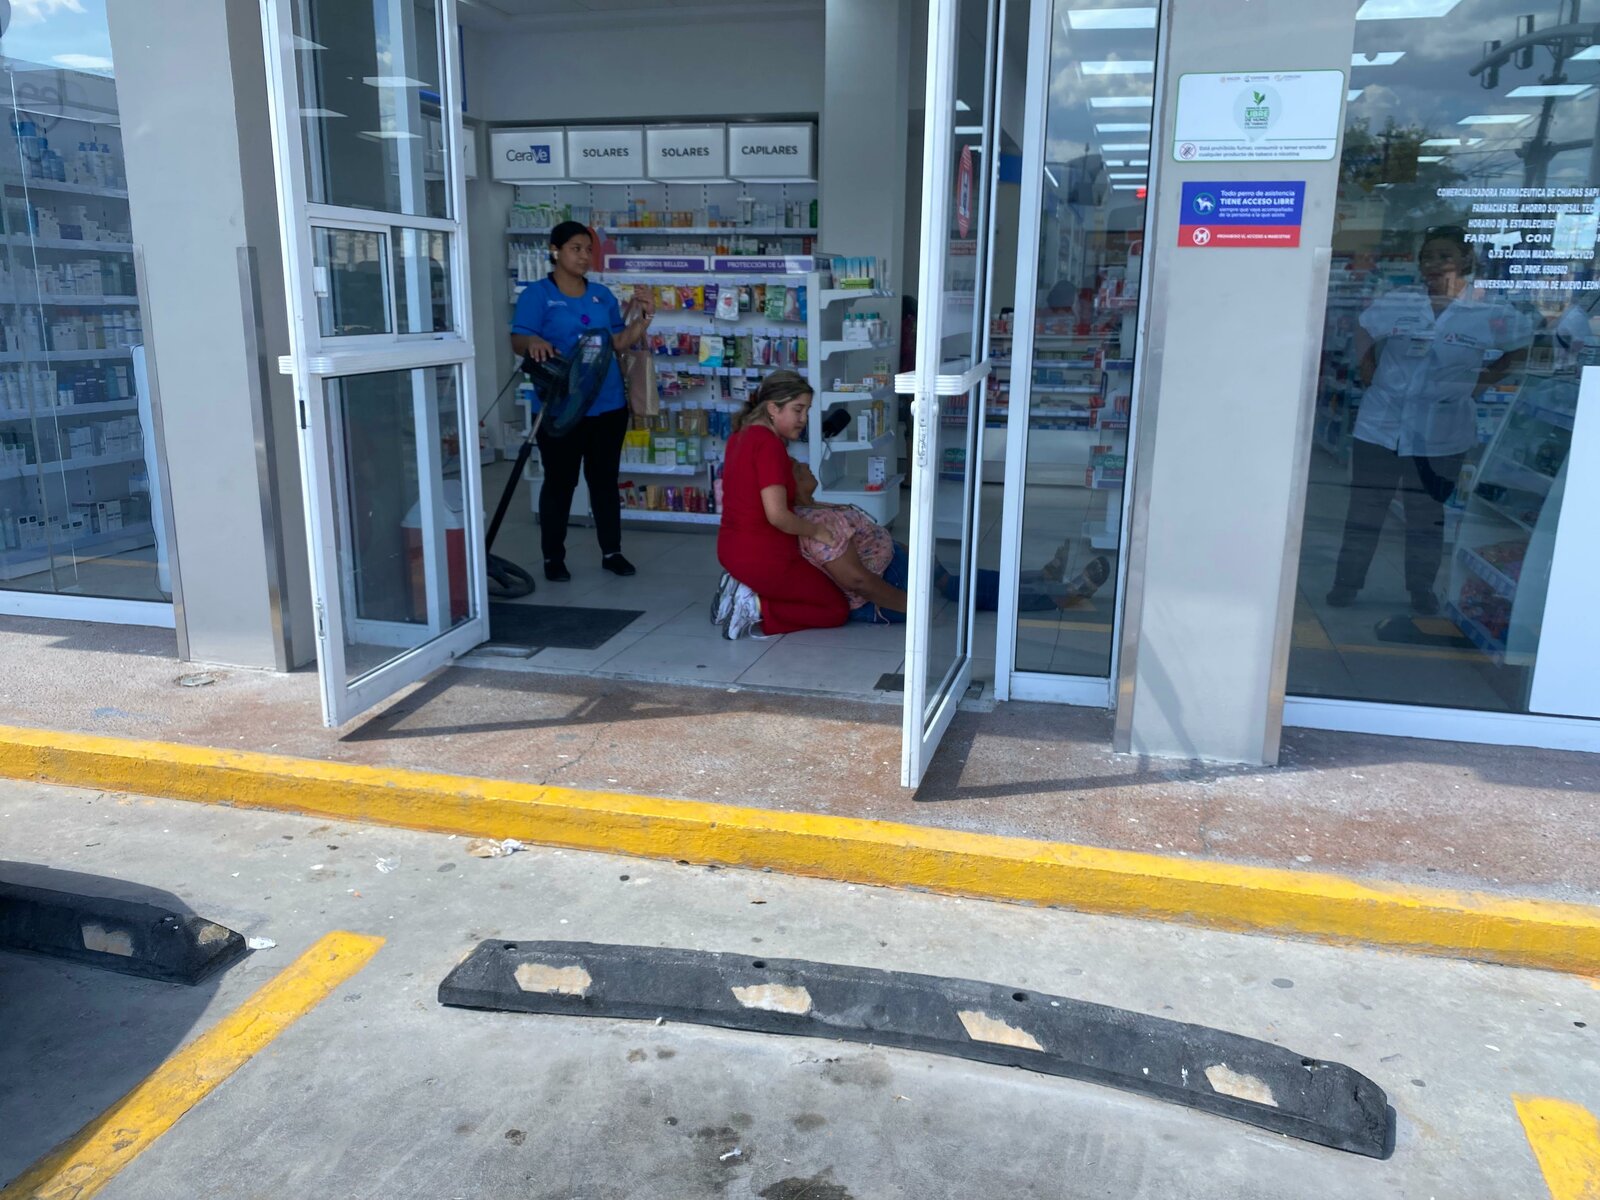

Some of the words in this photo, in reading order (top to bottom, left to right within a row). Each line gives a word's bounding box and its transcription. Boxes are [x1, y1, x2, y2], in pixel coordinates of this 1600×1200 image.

[506, 147, 548, 162] CeraVe
[583, 148, 629, 157] SOLARES
[662, 147, 710, 157] SOLARES
[741, 146, 798, 155] CAPILARES
[1436, 188, 1497, 197] COMERCIALIZADORA
[1499, 188, 1546, 197] FARMACEUTICA
[1547, 188, 1556, 197] DE
[1557, 188, 1583, 197] CHIAPAS
[1472, 204, 1507, 212] FARMACIAS
[1508, 204, 1519, 212] DEL
[1520, 204, 1546, 213] AHORRO
[1468, 219, 1496, 228] HORARIO
[1510, 219, 1556, 228] ESTABLECIMIE
[1526, 234, 1551, 243] CON
[1505, 250, 1531, 258] CLAUDIA
[1474, 280, 1514, 289] UNIVERSIDAD
[1516, 280, 1549, 289] AUTONOMA
[1550, 280, 1559, 289] DE
[1560, 280, 1581, 289] NUEVO
[1582, 281, 1598, 290] LEON
